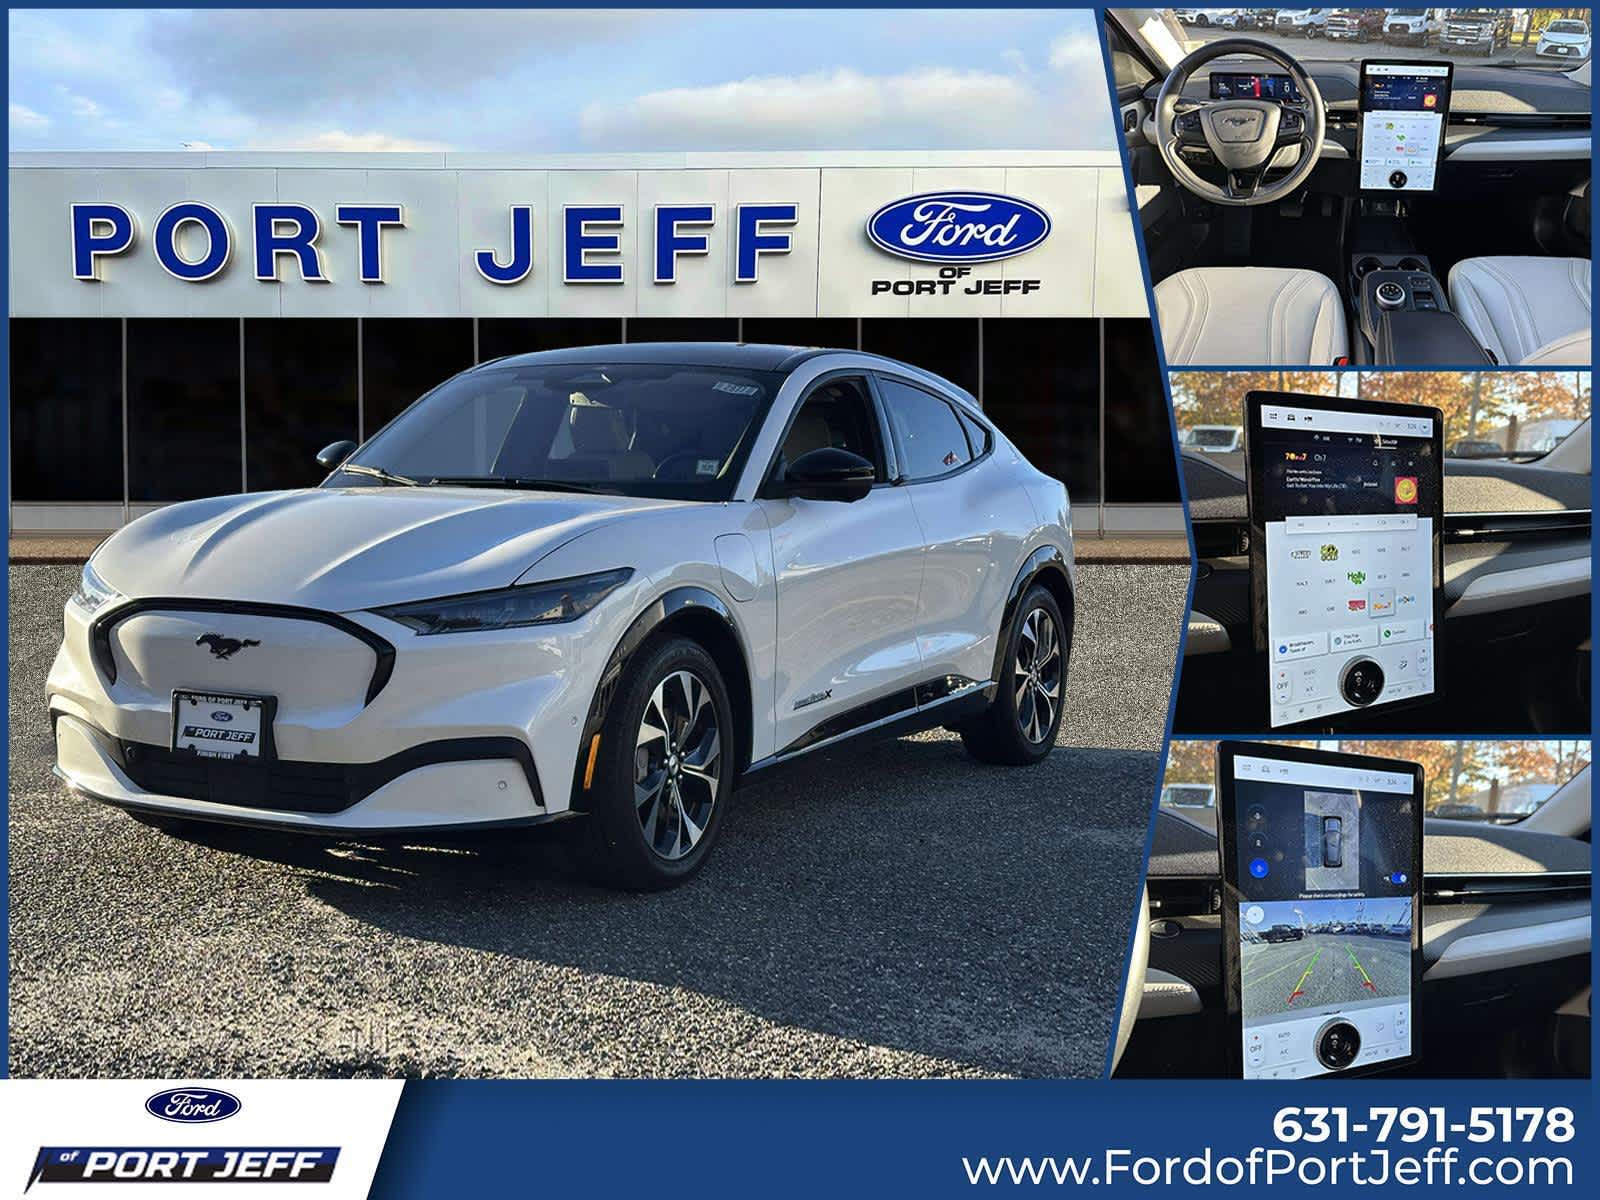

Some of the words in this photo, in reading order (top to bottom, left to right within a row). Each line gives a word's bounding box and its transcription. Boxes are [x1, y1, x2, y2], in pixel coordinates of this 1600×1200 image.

[900, 201, 1021, 246] Ford
[70, 201, 403, 281] PORT
[475, 202, 799, 284] JEFF
[939, 267, 971, 279] OF
[871, 280, 956, 296] PORT
[964, 279, 1041, 295] JEFF
[195, 728, 225, 739] PORT
[226, 732, 253, 742] JEFF
[1250, 1045, 1262, 1053] OFF
